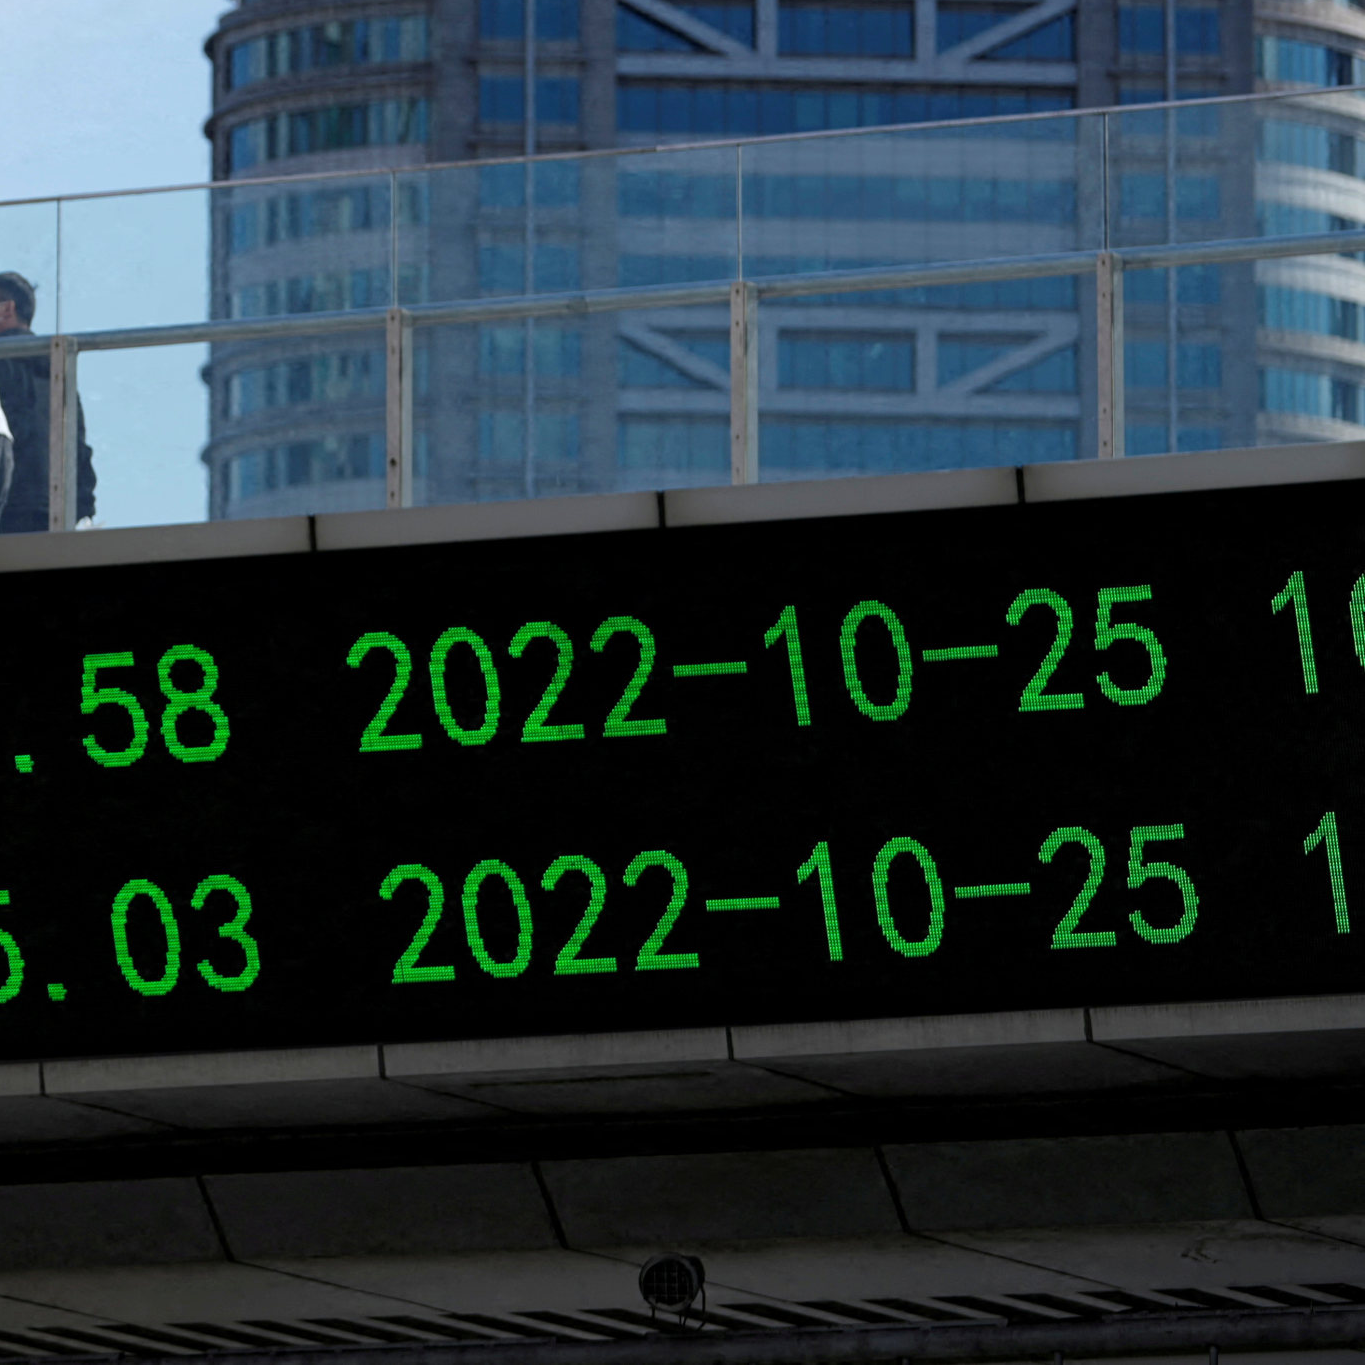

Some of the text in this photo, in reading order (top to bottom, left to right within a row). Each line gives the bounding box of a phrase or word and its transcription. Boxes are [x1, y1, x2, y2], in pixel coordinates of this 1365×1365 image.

[347, 585, 1168, 754] 2022-10-25
[1272, 571, 1365, 694] 1
[379, 823, 1200, 985] 2022-10-25
